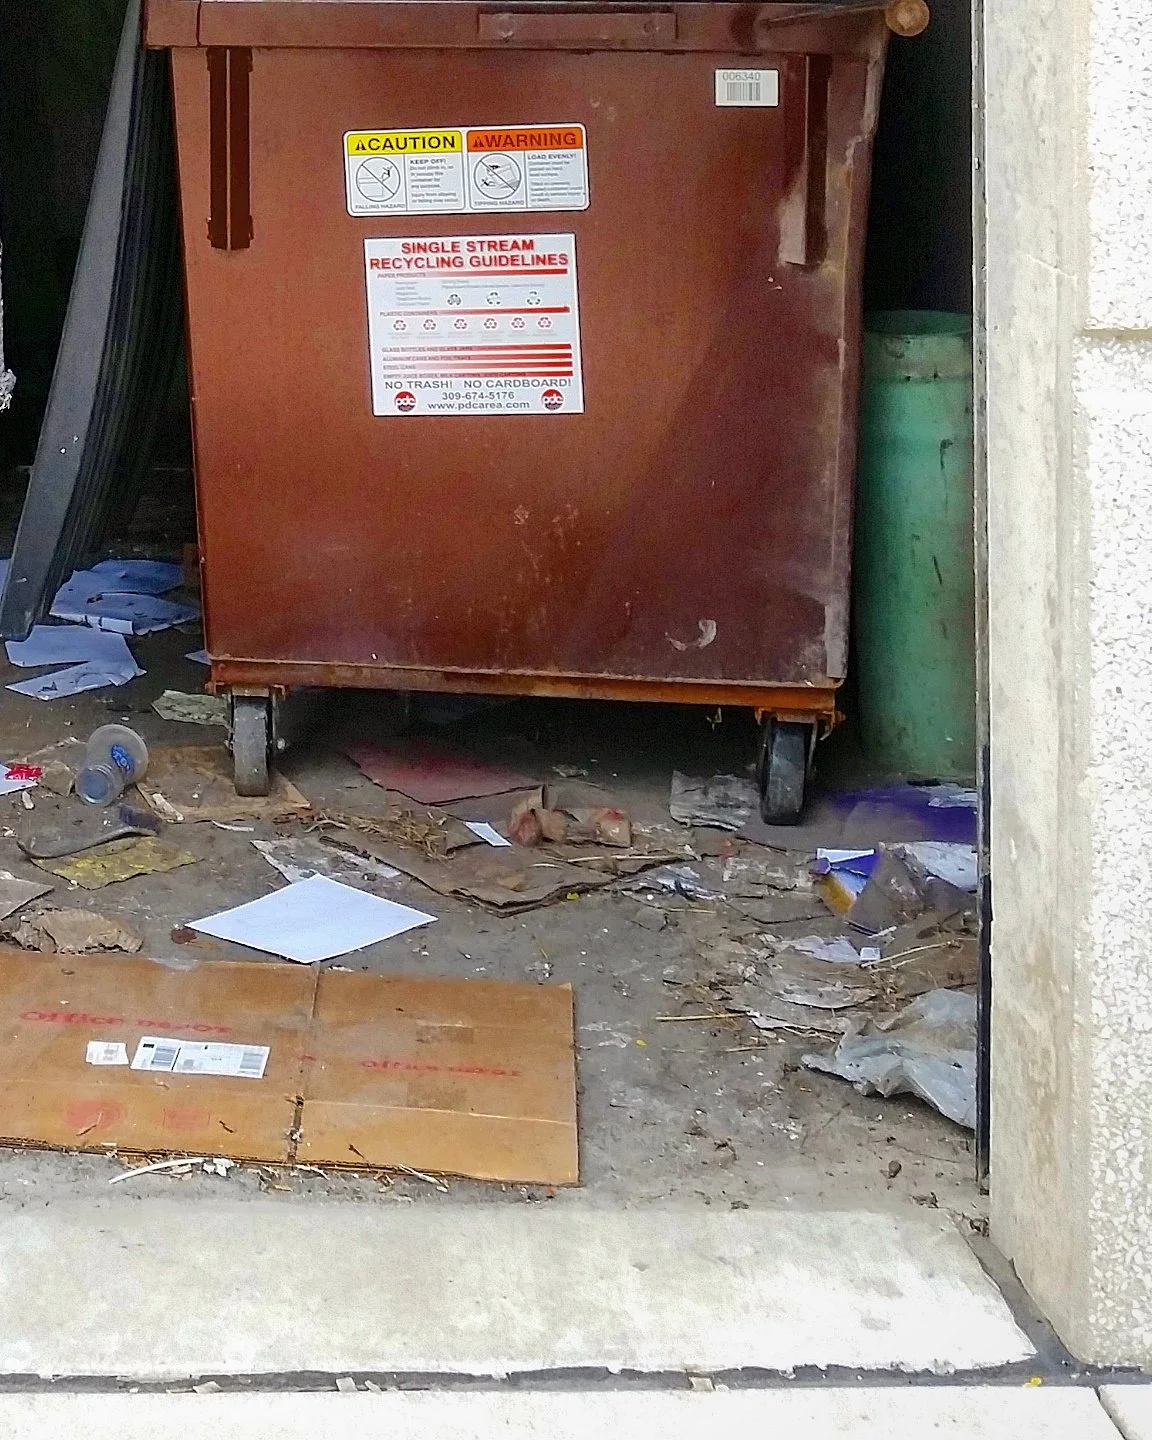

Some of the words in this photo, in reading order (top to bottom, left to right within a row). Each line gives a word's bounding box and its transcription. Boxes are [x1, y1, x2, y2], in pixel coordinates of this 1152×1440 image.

[368, 135, 456, 151] CAUTION
[483, 131, 577, 148] WARNING
[401, 240, 461, 254] SINGLE
[466, 239, 534, 252] STREAM
[370, 256, 464, 270] RECYCLING
[469, 253, 569, 268] GUIDELINES
[385, 380, 403, 389] NO
[407, 380, 453, 389] TRASH!
[463, 379, 483, 389] NO
[486, 378, 572, 388] CARDBOARD!
[442, 391, 515, 401] 309-674-5176
[428, 400, 530, 411] www.pdcarea.com
